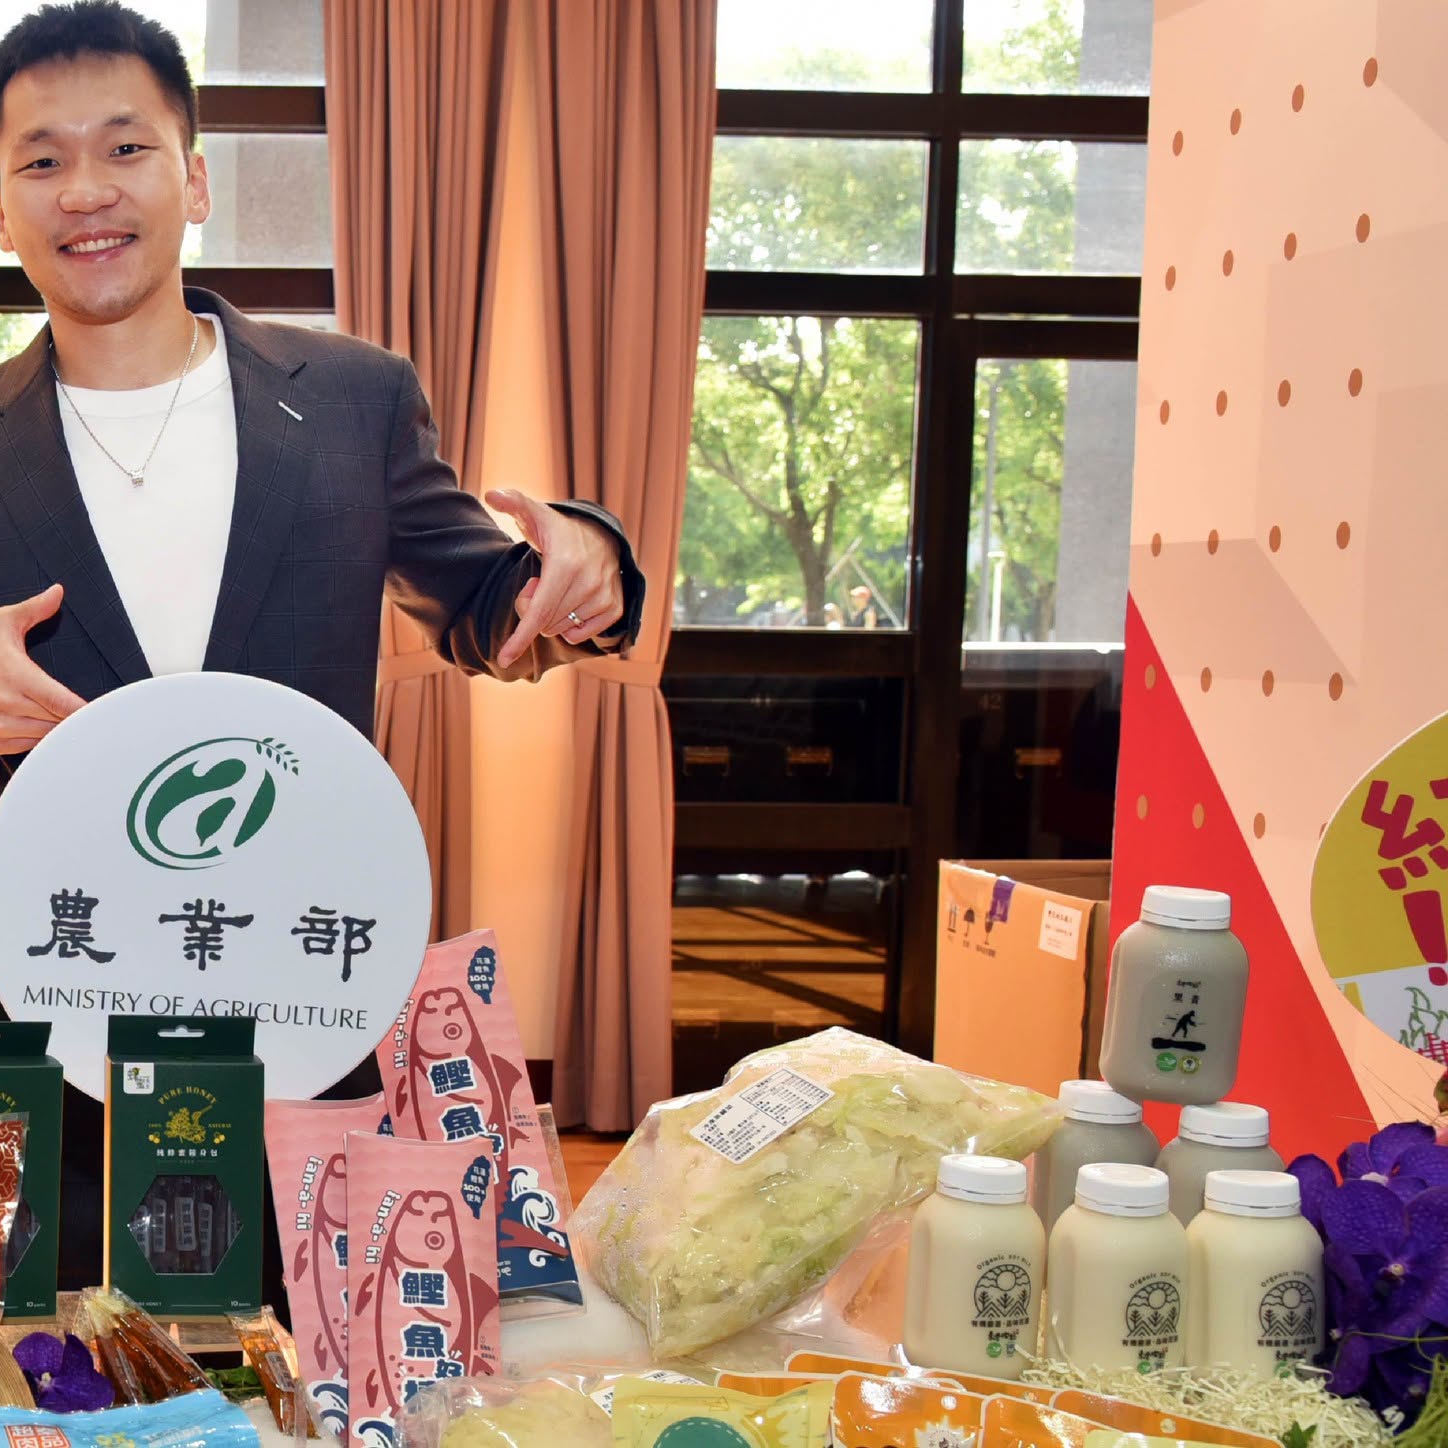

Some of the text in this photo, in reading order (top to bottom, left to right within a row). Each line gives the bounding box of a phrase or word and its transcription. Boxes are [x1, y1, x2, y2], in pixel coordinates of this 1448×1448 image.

[26, 888, 377, 982] 農業部
[23, 985, 368, 1030] MINISTRY OF AGRICULTURE
[186, 1085, 217, 1104] HONEY
